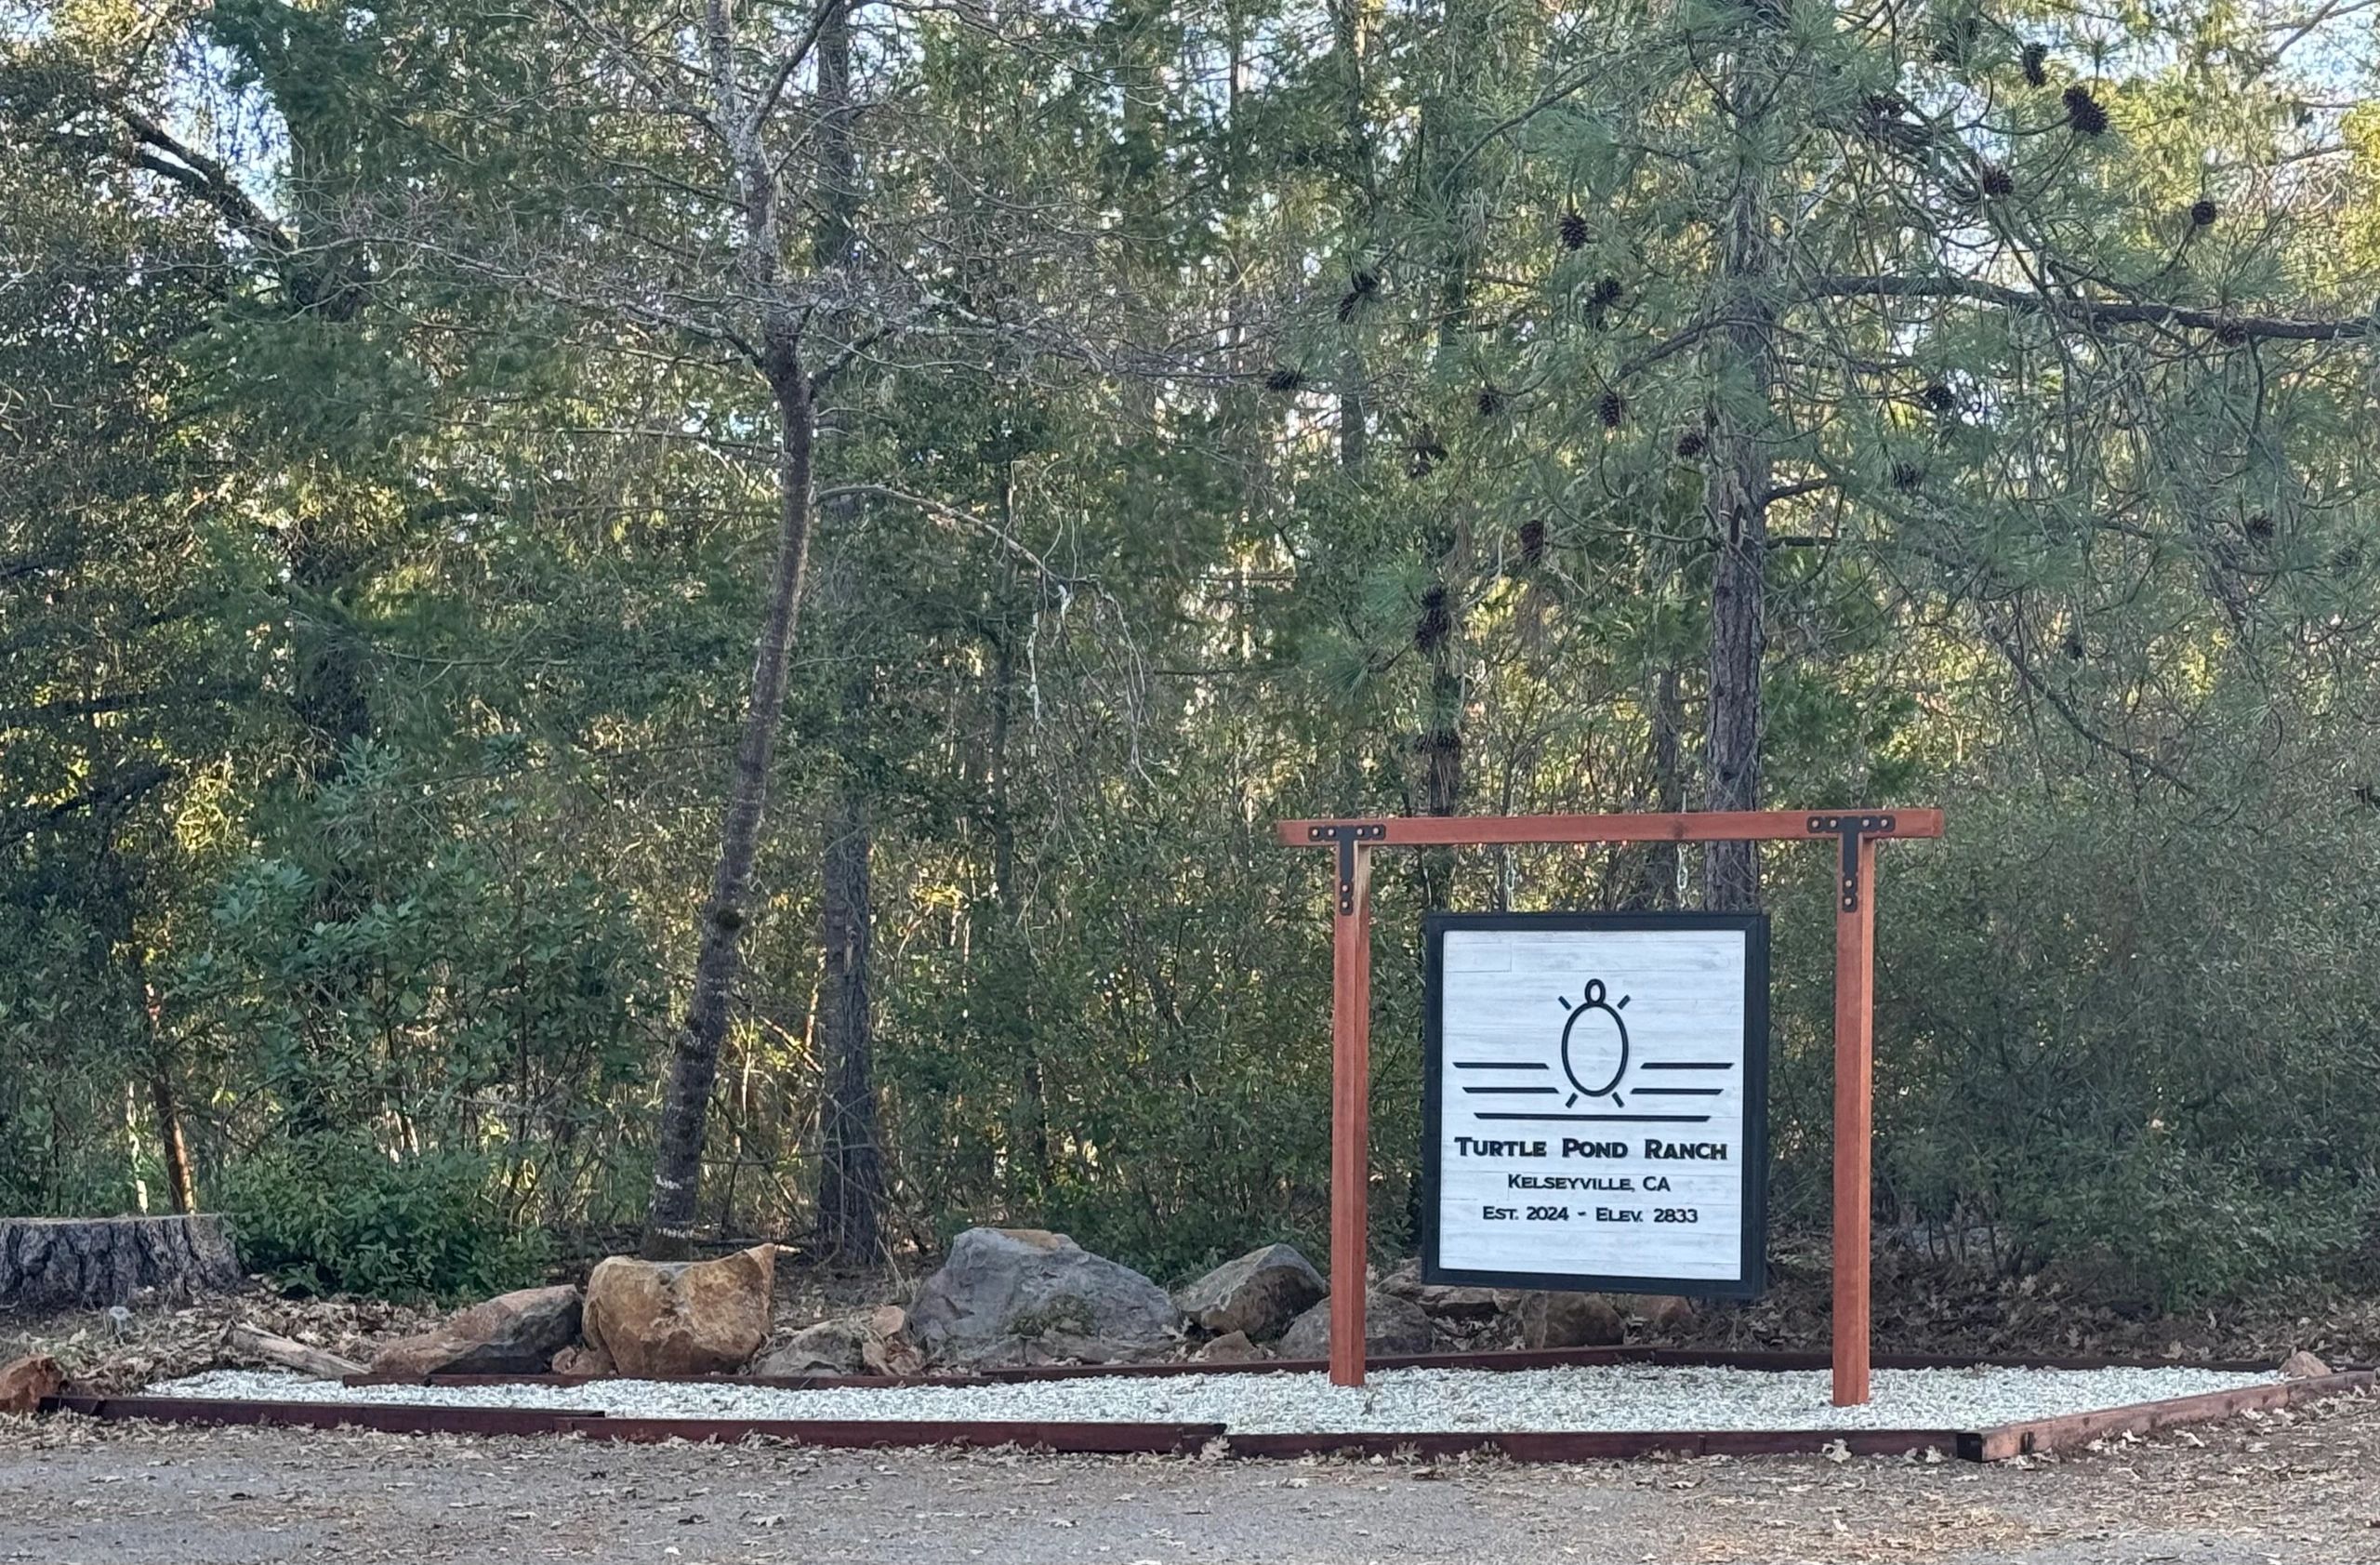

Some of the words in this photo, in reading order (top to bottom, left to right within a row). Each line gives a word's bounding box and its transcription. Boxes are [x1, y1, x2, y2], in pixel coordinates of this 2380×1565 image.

[1454, 1136, 1547, 1158] TURTLE
[1562, 1137, 1629, 1159] POND
[1644, 1138, 1728, 1160] RANCH
[1508, 1174, 1635, 1193] KELSEYVILLE,
[1642, 1175, 1672, 1192] CA
[1482, 1205, 1520, 1221] EST.
[1526, 1206, 1569, 1222] 2024
[1653, 1208, 1699, 1224] 2833
